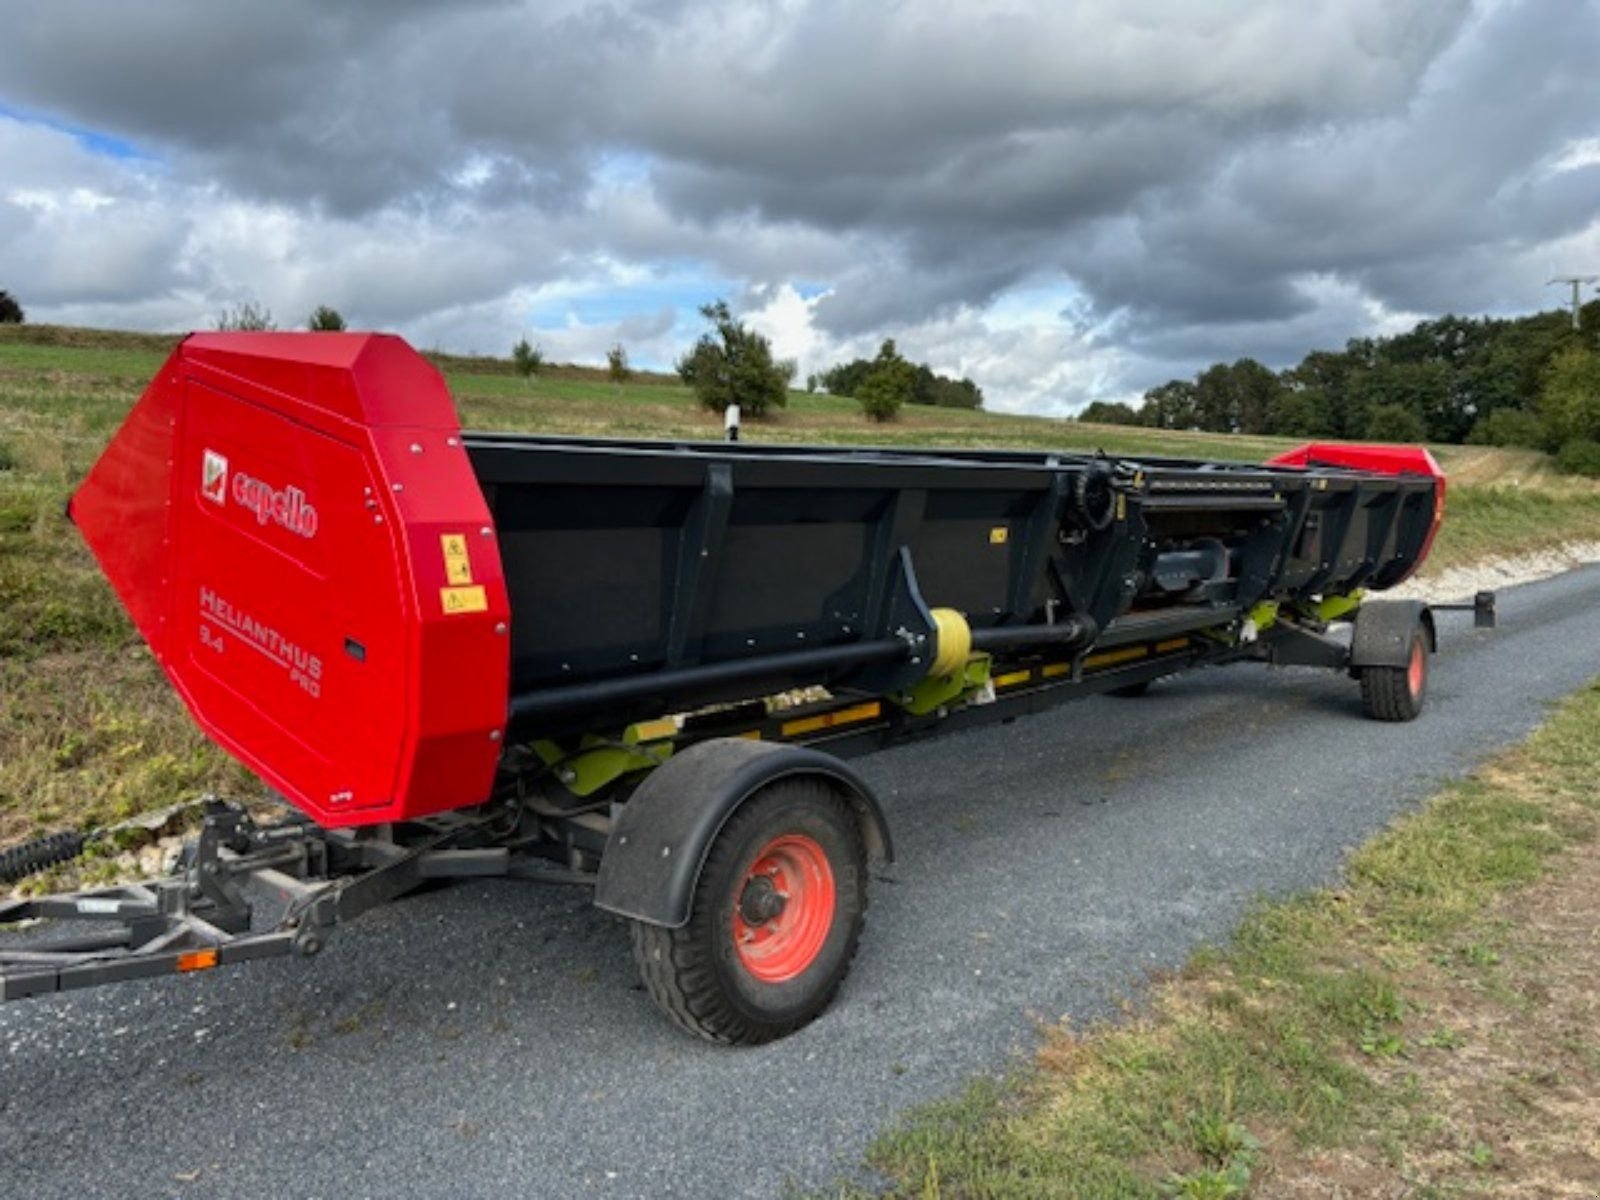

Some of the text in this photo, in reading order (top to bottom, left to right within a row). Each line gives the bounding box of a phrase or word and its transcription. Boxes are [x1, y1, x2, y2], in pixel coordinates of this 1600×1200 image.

[232, 472, 318, 538] capello
[199, 587, 323, 677] HELIANTHUS
[289, 669, 320, 698] PRO
